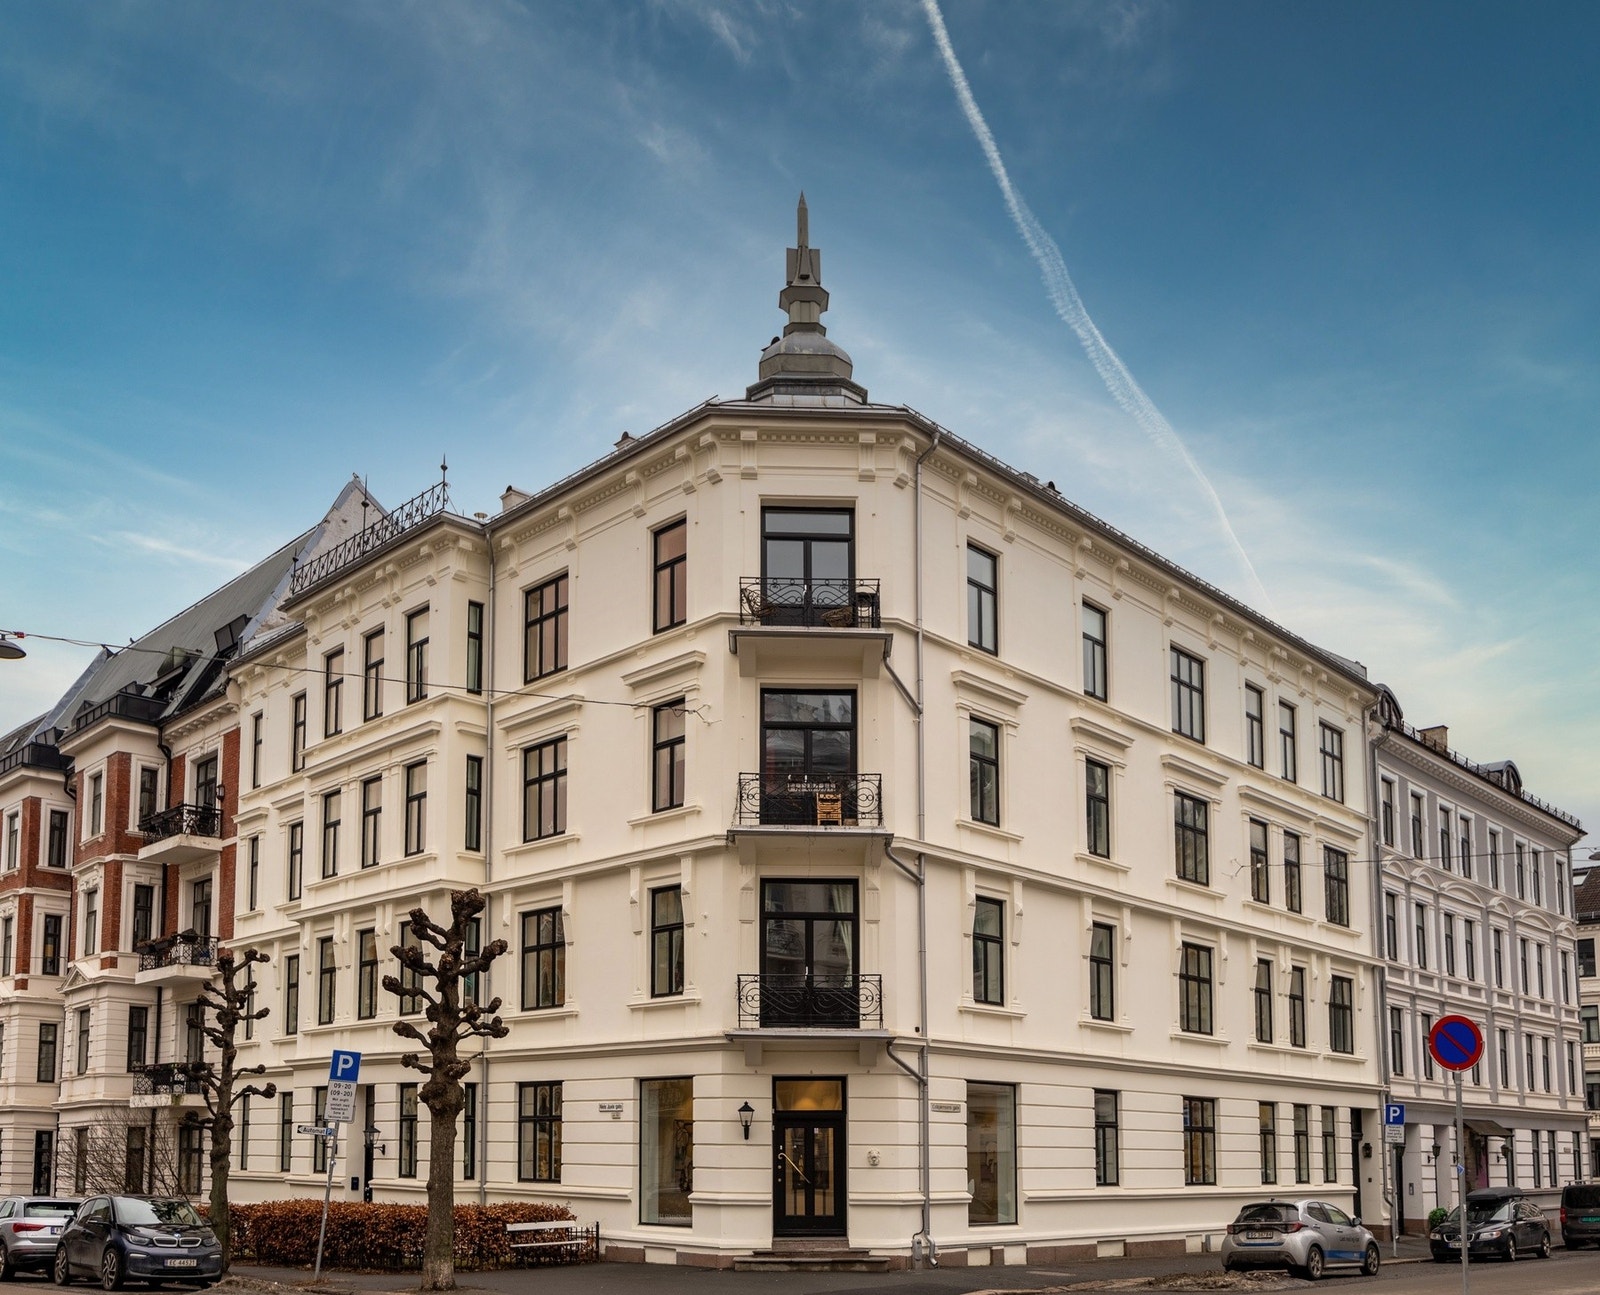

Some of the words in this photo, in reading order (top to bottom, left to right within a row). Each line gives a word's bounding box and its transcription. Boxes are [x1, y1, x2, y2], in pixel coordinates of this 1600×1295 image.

[336, 1054, 354, 1076] P
[1390, 1106, 1401, 1123] P
[303, 1127, 325, 1135] Automat
